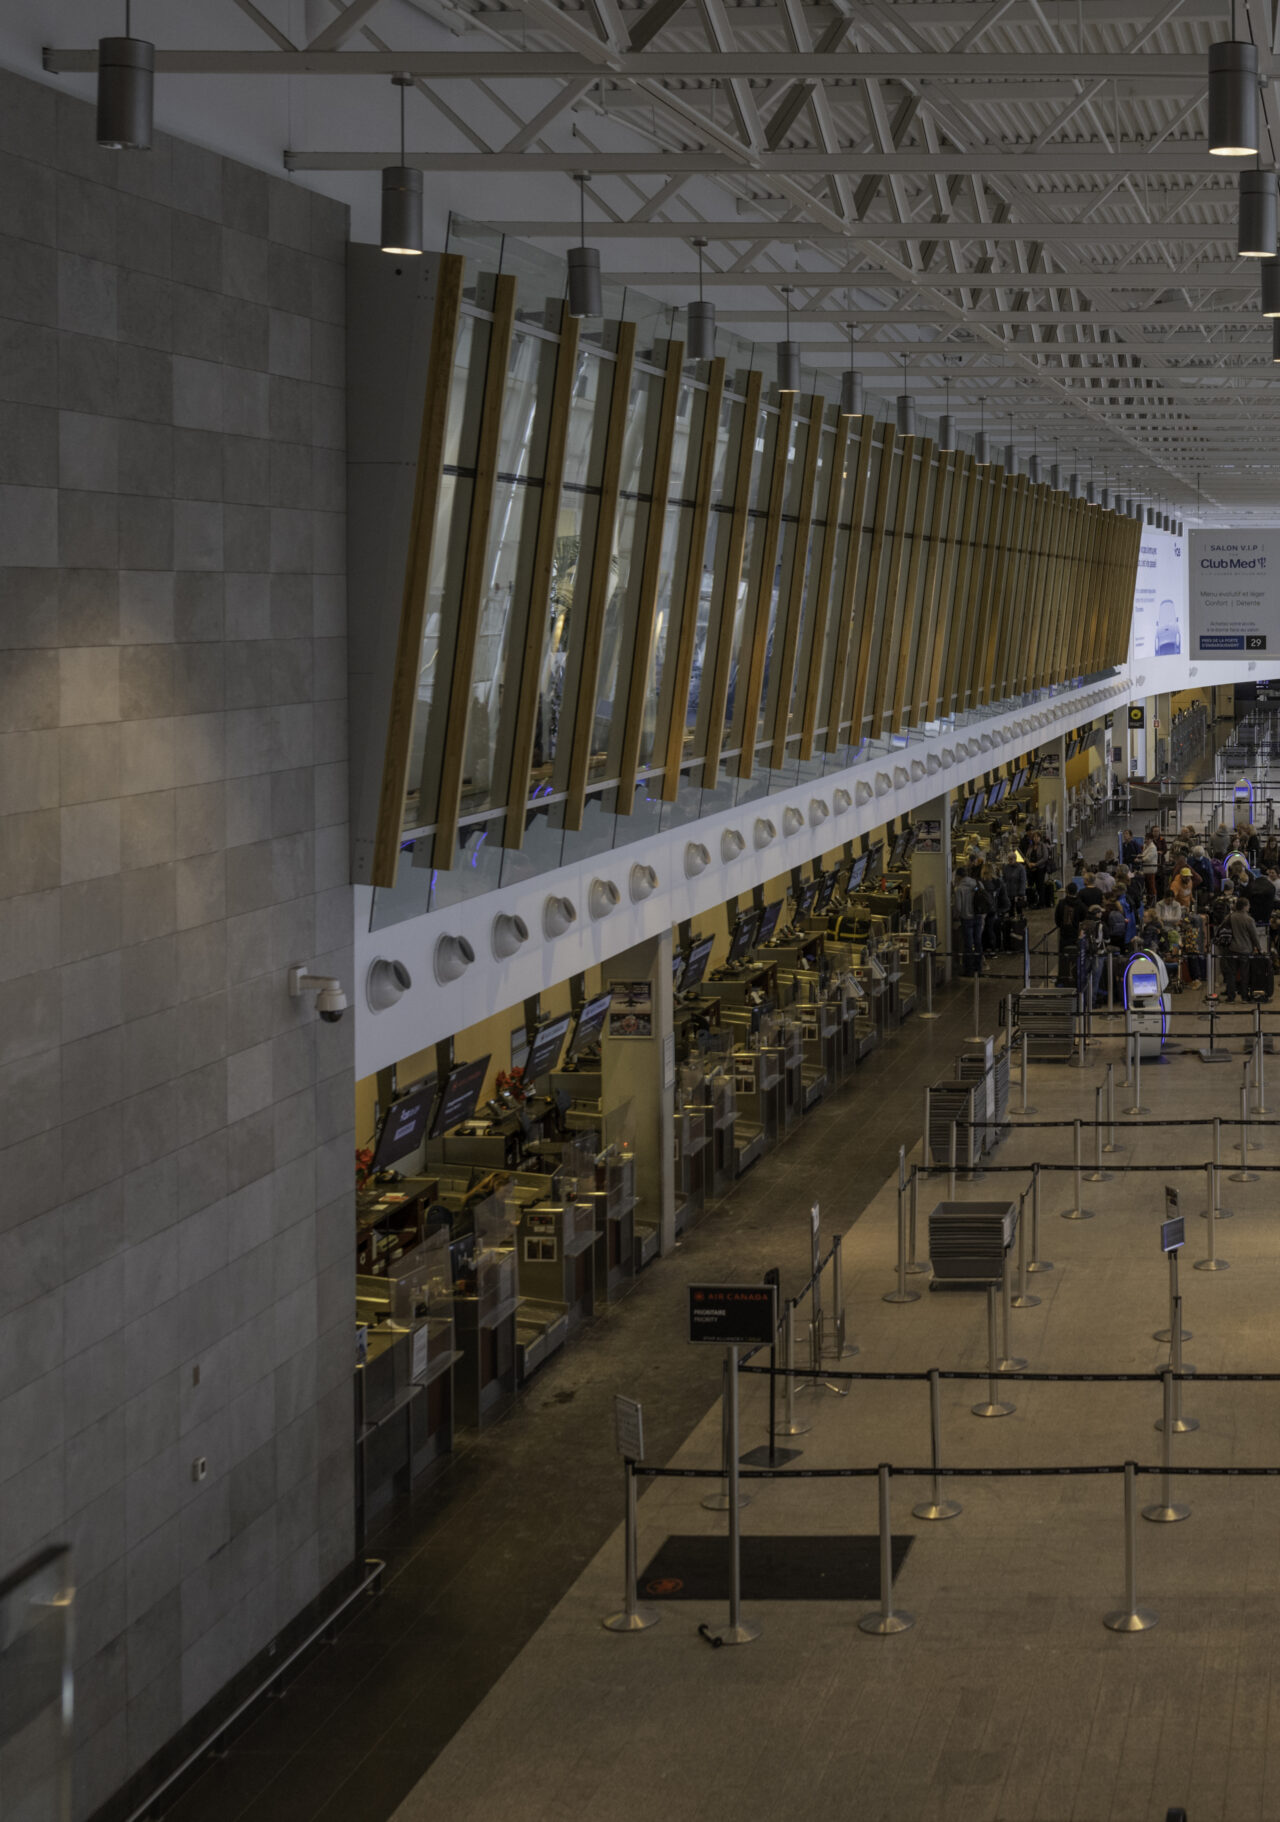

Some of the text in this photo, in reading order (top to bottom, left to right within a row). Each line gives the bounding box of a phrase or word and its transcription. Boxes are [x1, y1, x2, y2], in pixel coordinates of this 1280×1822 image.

[1200, 558, 1256, 569] Club Med
[1250, 638, 1262, 647] 29
[709, 1292, 768, 1301] AIR CANADA
